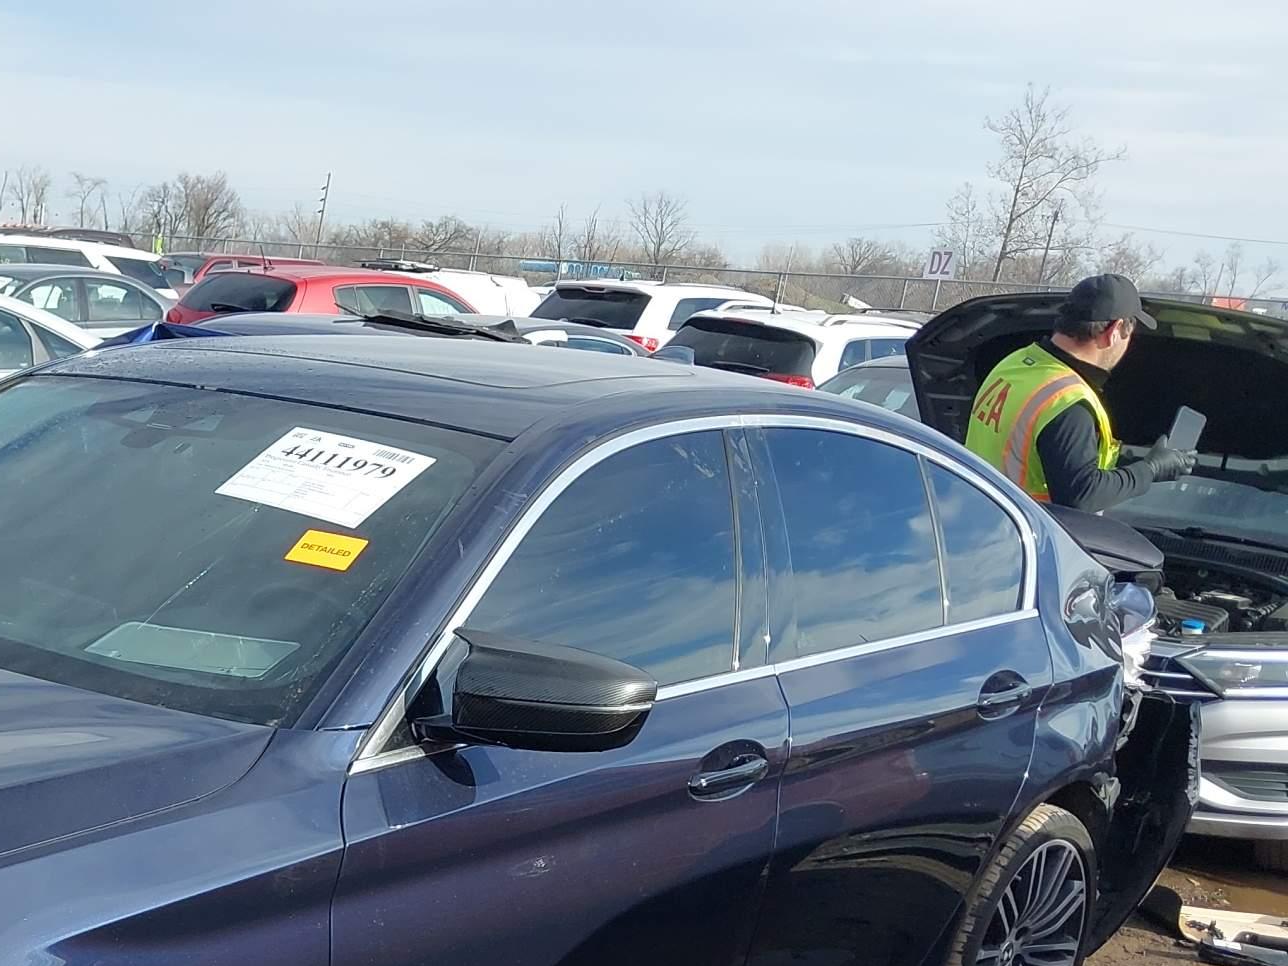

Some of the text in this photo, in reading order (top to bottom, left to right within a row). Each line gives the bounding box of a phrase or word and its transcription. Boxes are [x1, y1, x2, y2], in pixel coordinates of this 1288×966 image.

[928, 251, 953, 275] DZ
[281, 444, 397, 479] 44111979
[300, 542, 352, 557] DETAILED
